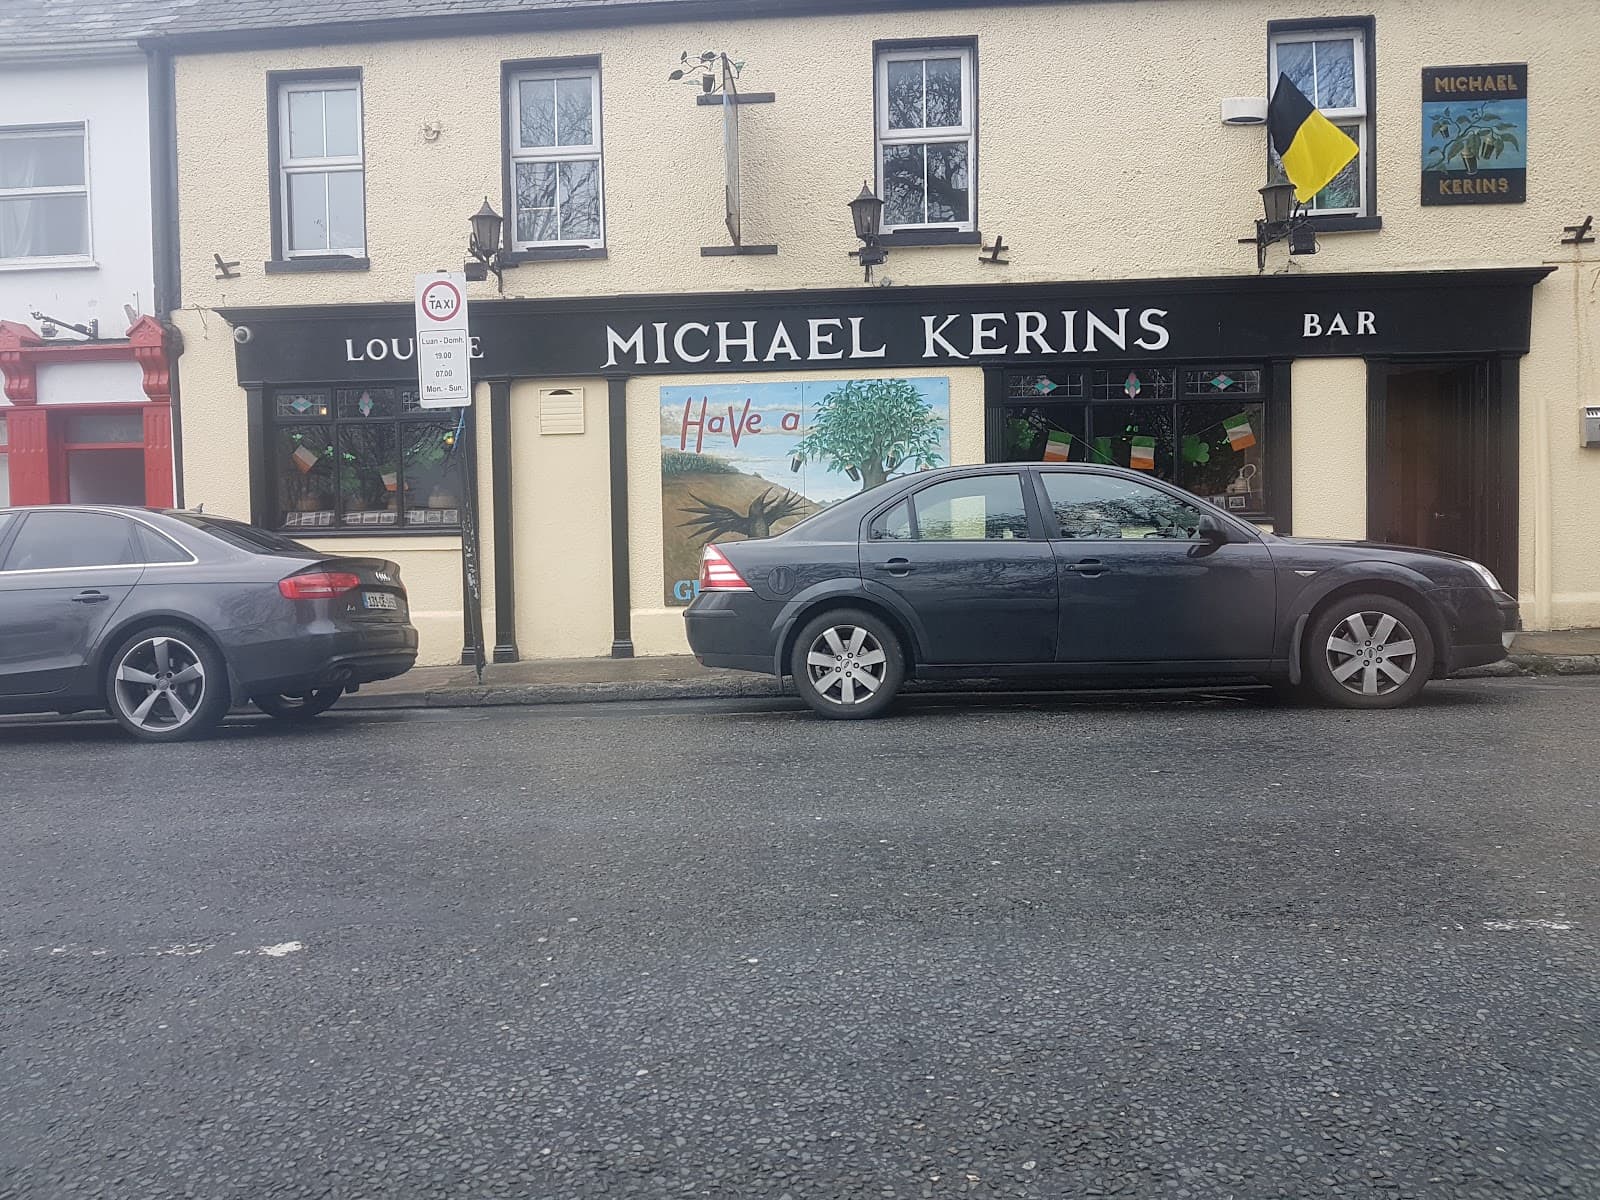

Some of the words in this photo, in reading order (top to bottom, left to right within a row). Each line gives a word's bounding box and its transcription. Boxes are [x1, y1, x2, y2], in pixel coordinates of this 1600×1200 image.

[1434, 74, 1518, 93] MICHAEL
[1440, 177, 1510, 195] KERINS
[429, 299, 454, 310] TAXI
[1302, 310, 1377, 337] BAR
[600, 317, 887, 368] MICHAEL
[921, 308, 1170, 359] KERINS
[345, 336, 484, 361] LOUE
[435, 370, 453, 378] 07.00
[426, 385, 442, 393] Mon.
[448, 384, 464, 392] Sun.
[781, 412, 801, 431] a
